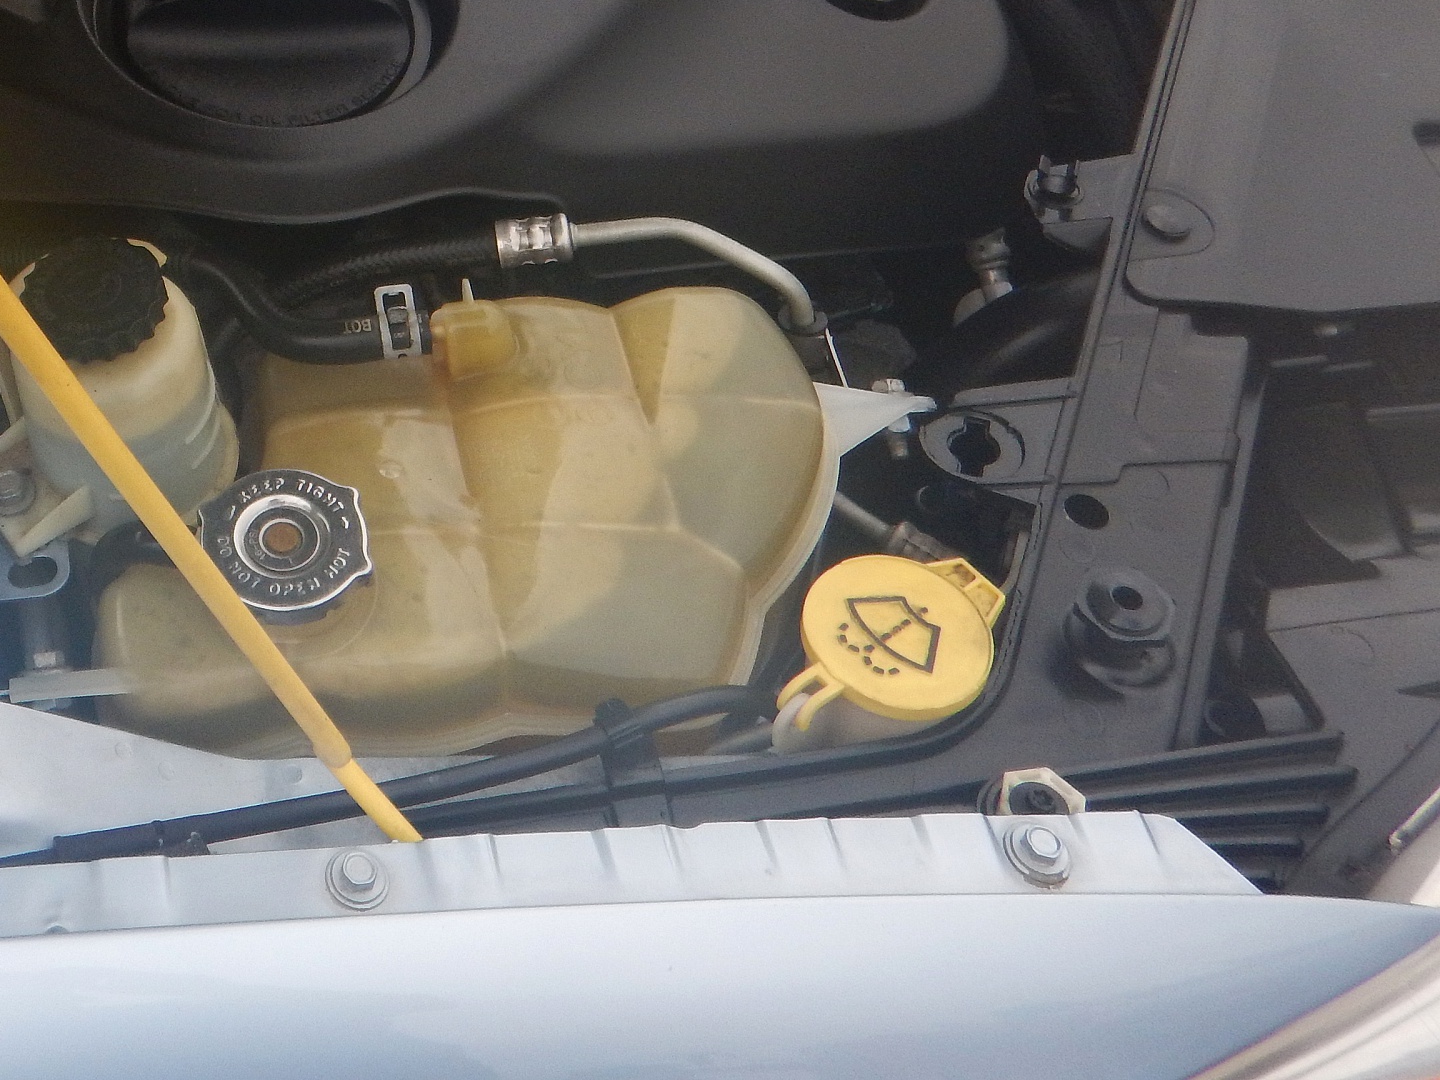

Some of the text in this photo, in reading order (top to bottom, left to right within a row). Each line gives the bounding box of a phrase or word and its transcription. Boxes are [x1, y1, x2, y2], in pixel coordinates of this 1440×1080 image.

[240, 477, 345, 513] KEEP TIGHT
[217, 535, 351, 596] DO NOT OPEN HOT
